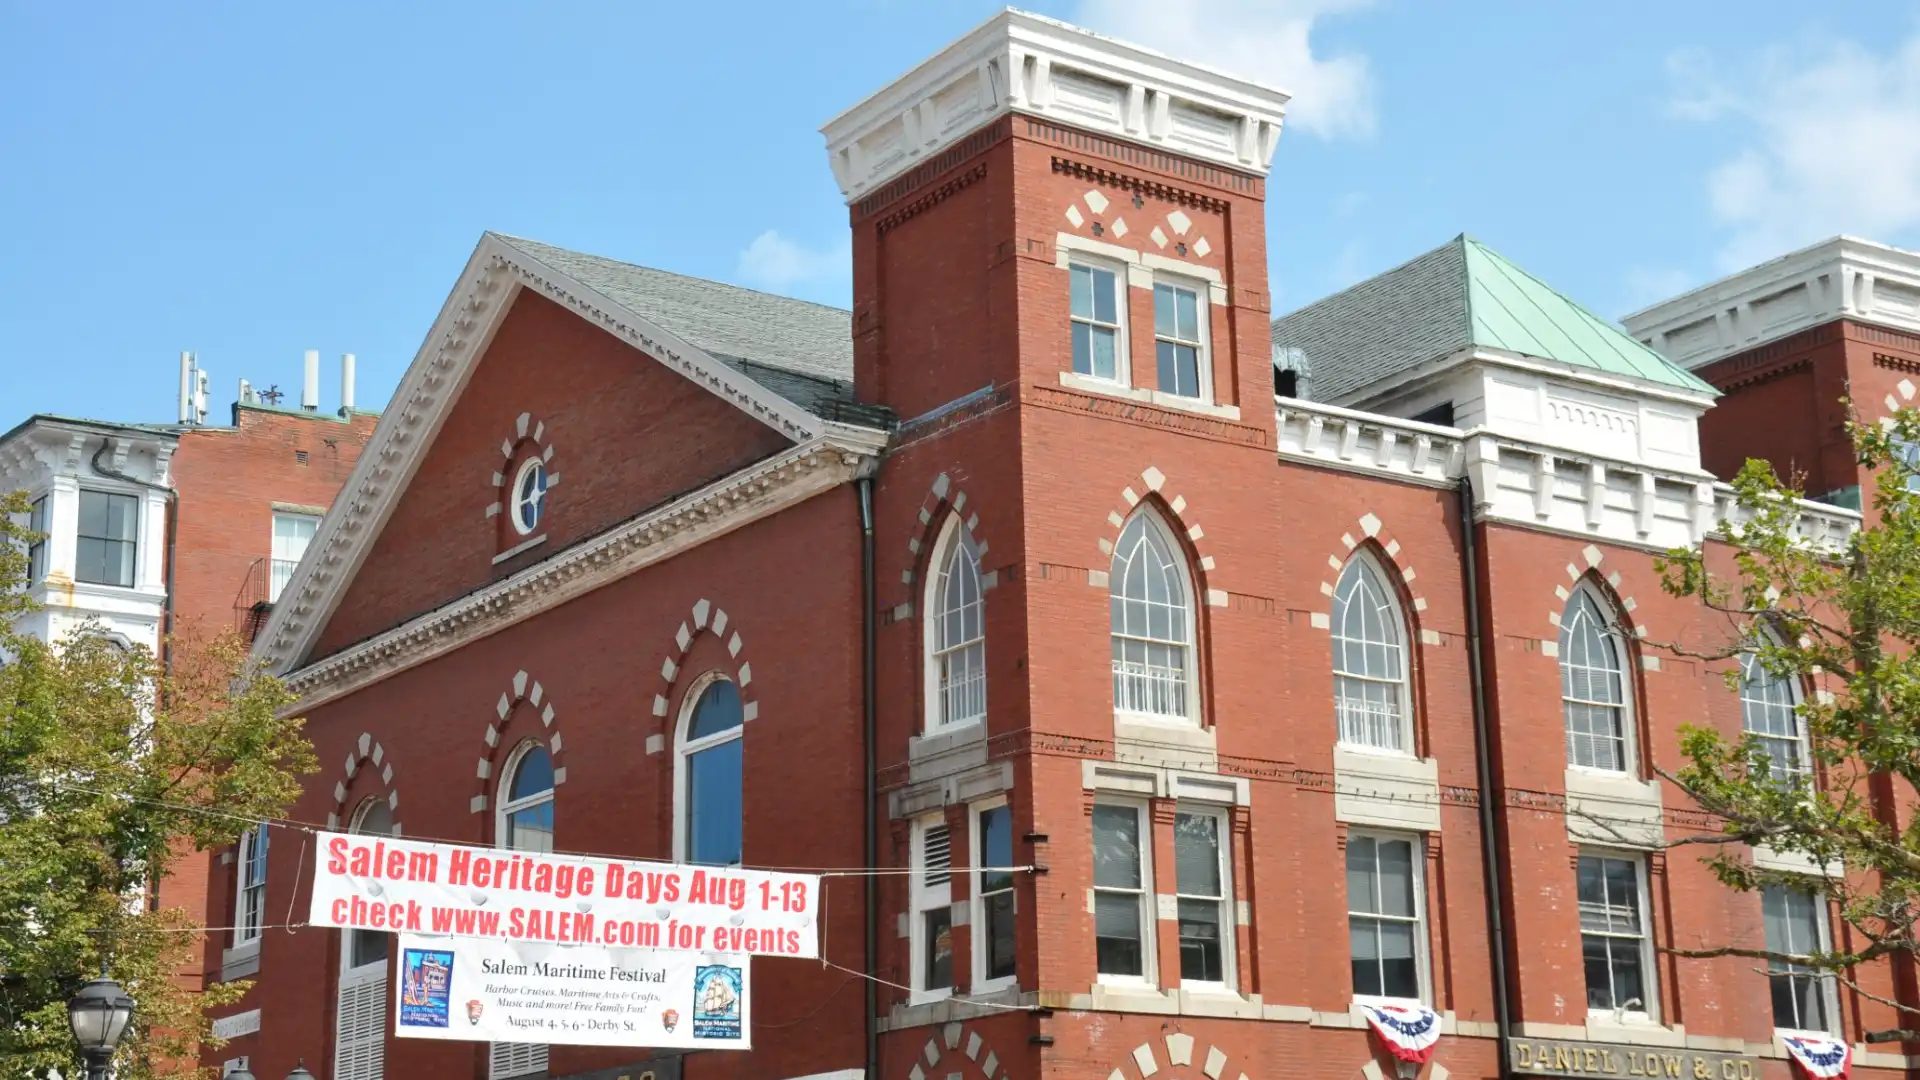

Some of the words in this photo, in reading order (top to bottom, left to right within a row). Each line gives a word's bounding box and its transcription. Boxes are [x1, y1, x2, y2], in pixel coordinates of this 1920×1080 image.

[328, 837, 438, 883] Salem
[448, 849, 594, 898] Heritage
[604, 863, 680, 904] Days
[688, 870, 746, 911] Aug
[758, 879, 807, 912] 1-13
[331, 895, 422, 931] check
[432, 907, 659, 946] www.SALEM.com
[668, 919, 706, 949] for
[713, 926, 800, 954] events
[481, 958, 528, 976] Salem
[532, 962, 607, 980] Maritime
[609, 966, 667, 983] Festival
[484, 983, 518, 995] Harbor
[557, 989, 601, 1000] Maritime
[603, 991, 620, 1001] Arts
[621, 992, 630, 1001] &
[496, 997, 524, 1009] Music
[525, 1000, 545, 1010] and
[545, 1001, 573, 1011] more!
[574, 1003, 594, 1012] Free
[595, 1004, 625, 1015] Family
[626, 1005, 648, 1014] Fun!
[506, 1015, 545, 1029] August
[588, 1019, 621, 1033] Derby
[623, 1021, 637, 1032] St.
[1516, 1044, 1617, 1073] DANIEL
[1627, 1052, 1684, 1077] LOW
[1693, 1057, 1712, 1079] &
[1721, 1059, 1760, 1080] CO.
